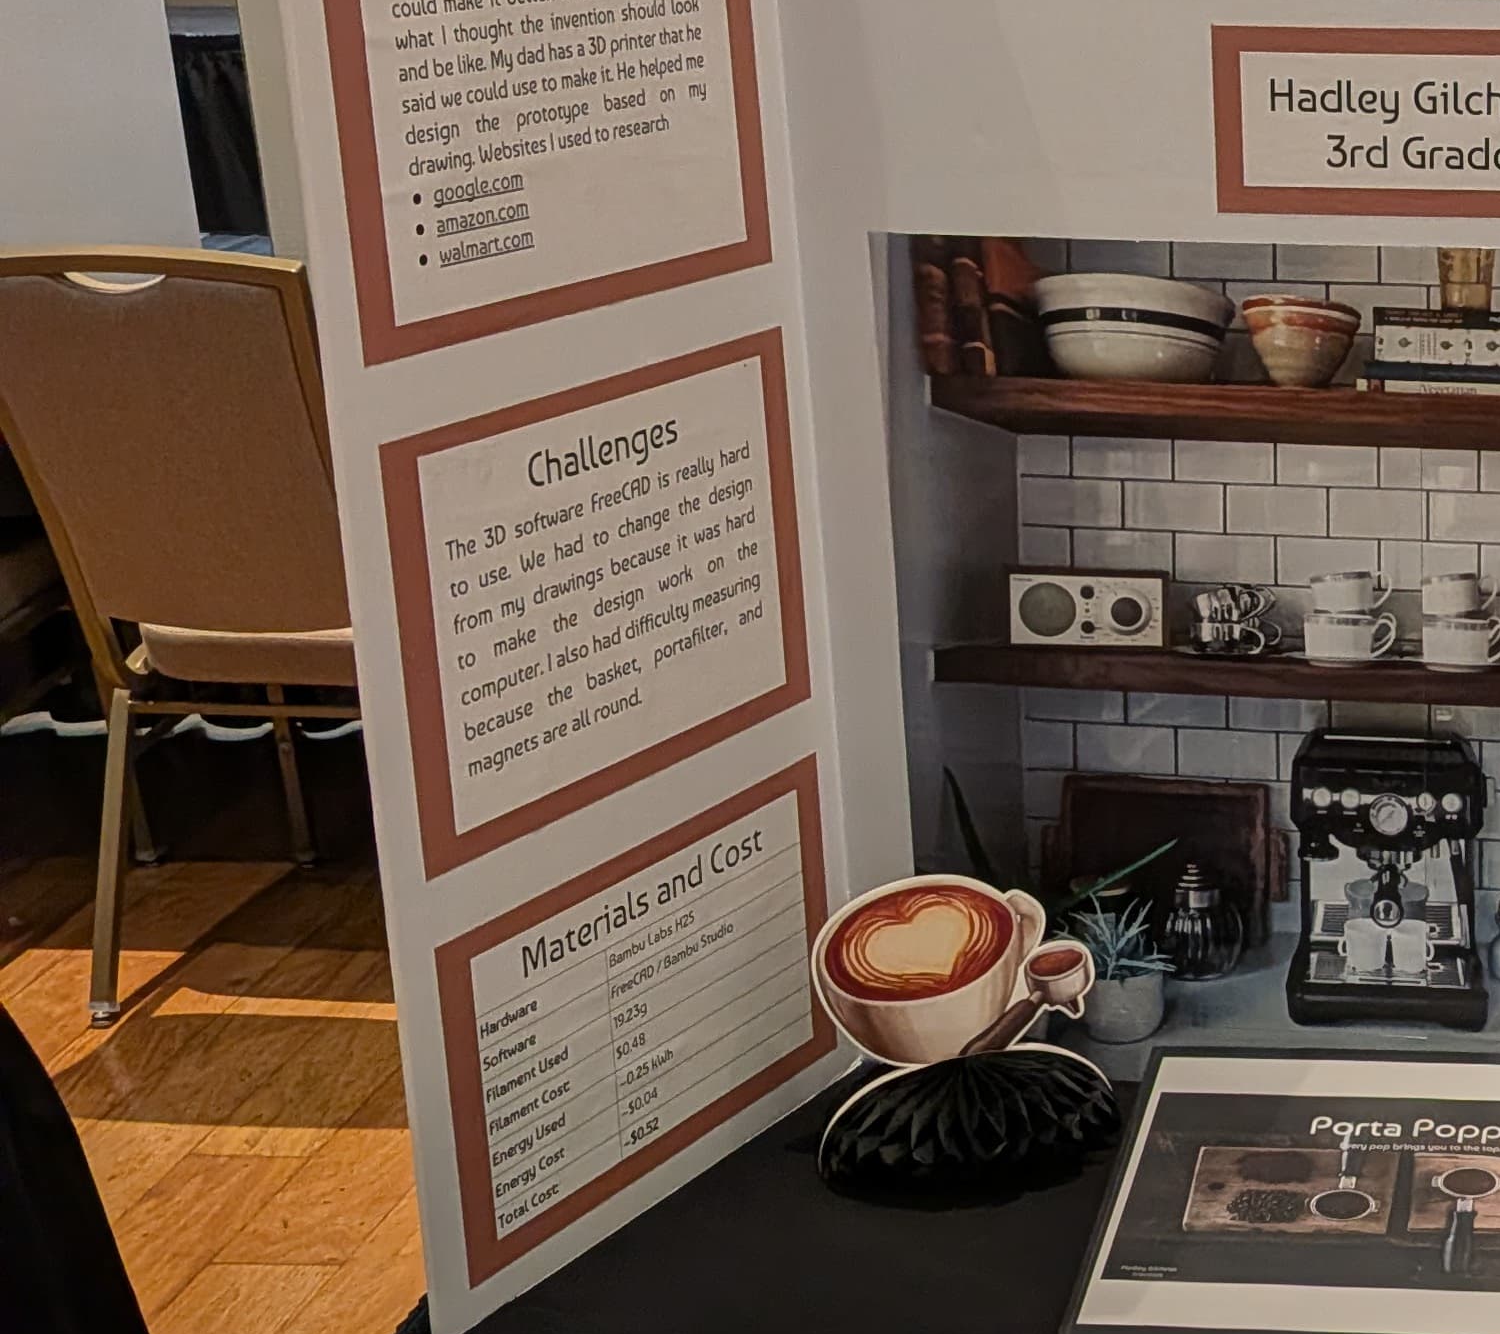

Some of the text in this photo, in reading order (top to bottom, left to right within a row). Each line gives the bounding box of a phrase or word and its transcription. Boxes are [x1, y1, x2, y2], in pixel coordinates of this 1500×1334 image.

[1269, 77, 1400, 125] Hadley
[1325, 133, 1389, 169] 3rd
[434, 171, 524, 208] google.com
[436, 201, 530, 237] amazon.com
[439, 230, 535, 267] walmart.com
[527, 419, 678, 488] Challenges
[444, 439, 751, 562] The 3D software FreeCAD is really hard
[521, 829, 764, 980] Materials and Cost
[479, 925, 673, 1039] Hardware Bambu Labs
[482, 1033, 537, 1072] Software
[486, 1046, 569, 1104] Filament Used
[1310, 1116, 1402, 1138] Porta
[1369, 1144, 1390, 1152] pop
[1428, 1144, 1447, 1152] you
[495, 1148, 566, 1198] Energy Cost
